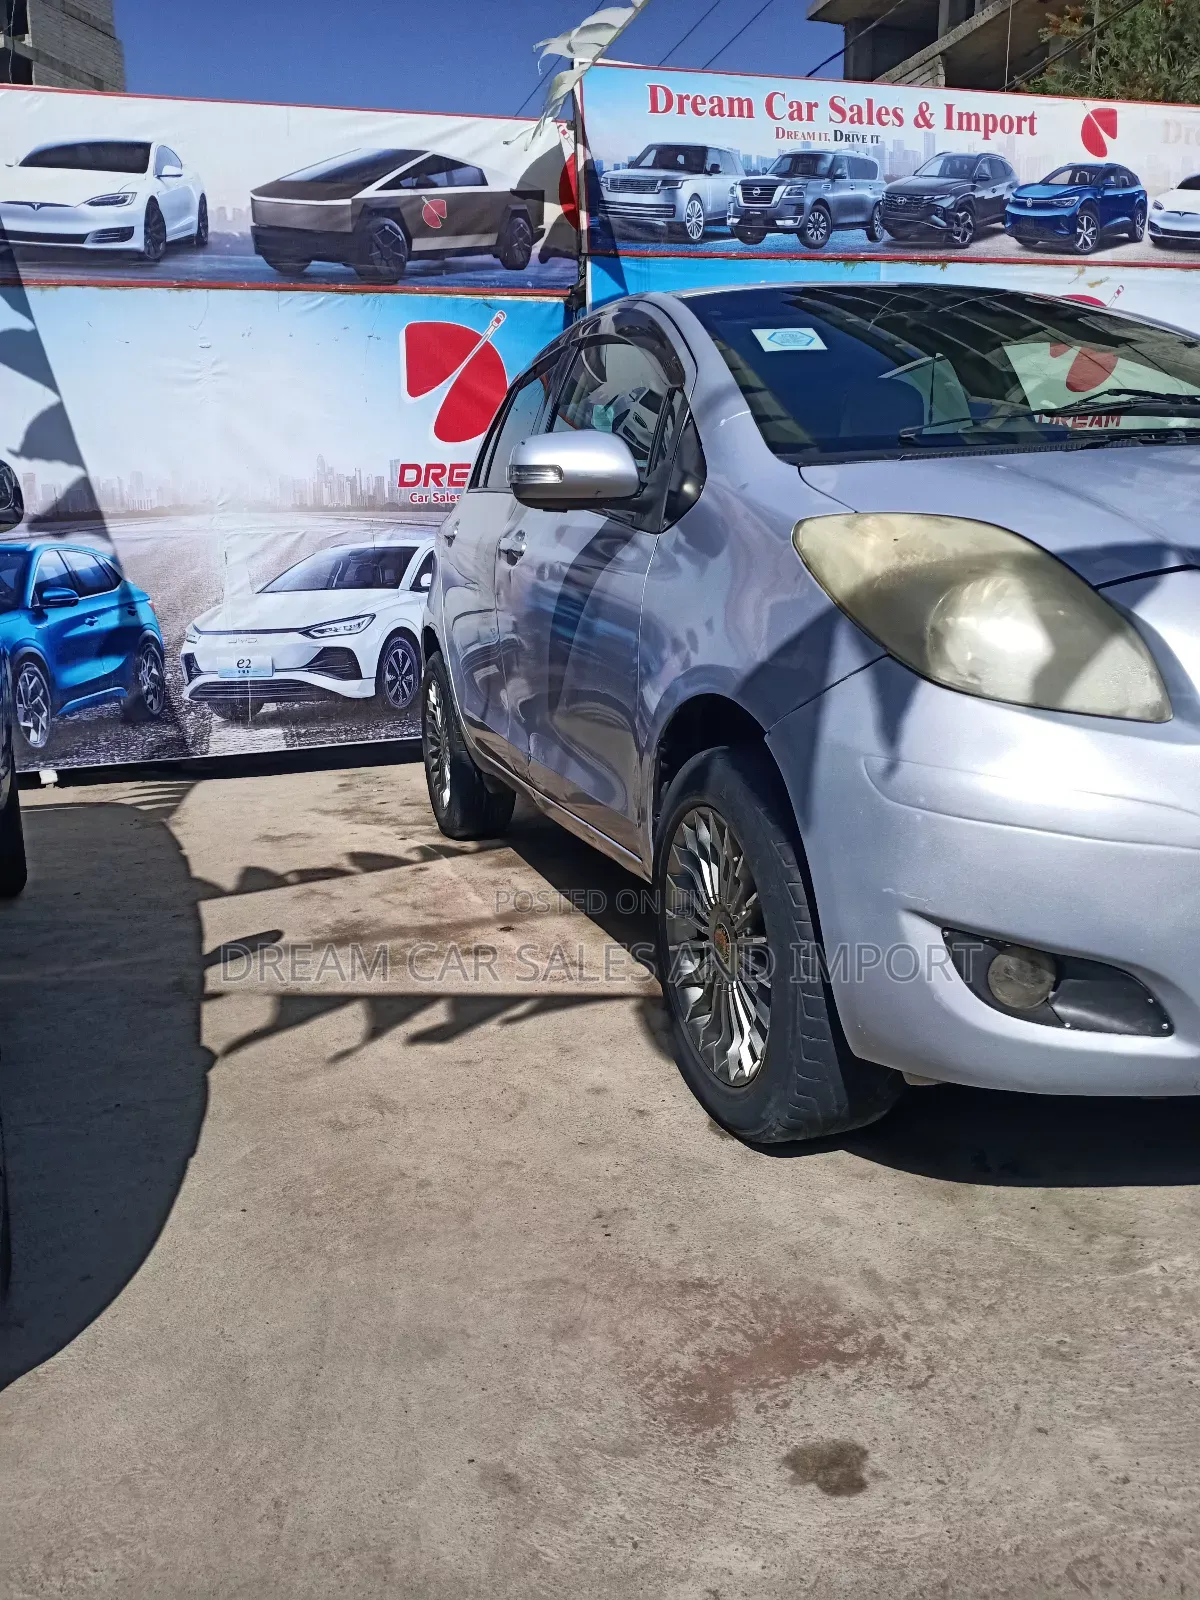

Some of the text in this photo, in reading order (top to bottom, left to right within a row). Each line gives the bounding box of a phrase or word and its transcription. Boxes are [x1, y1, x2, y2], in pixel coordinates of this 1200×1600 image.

[646, 84, 1038, 140] Dream Car Sales & Import
[398, 463, 472, 488] DRE
[409, 492, 429, 503] Car
[236, 658, 252, 669] e2
